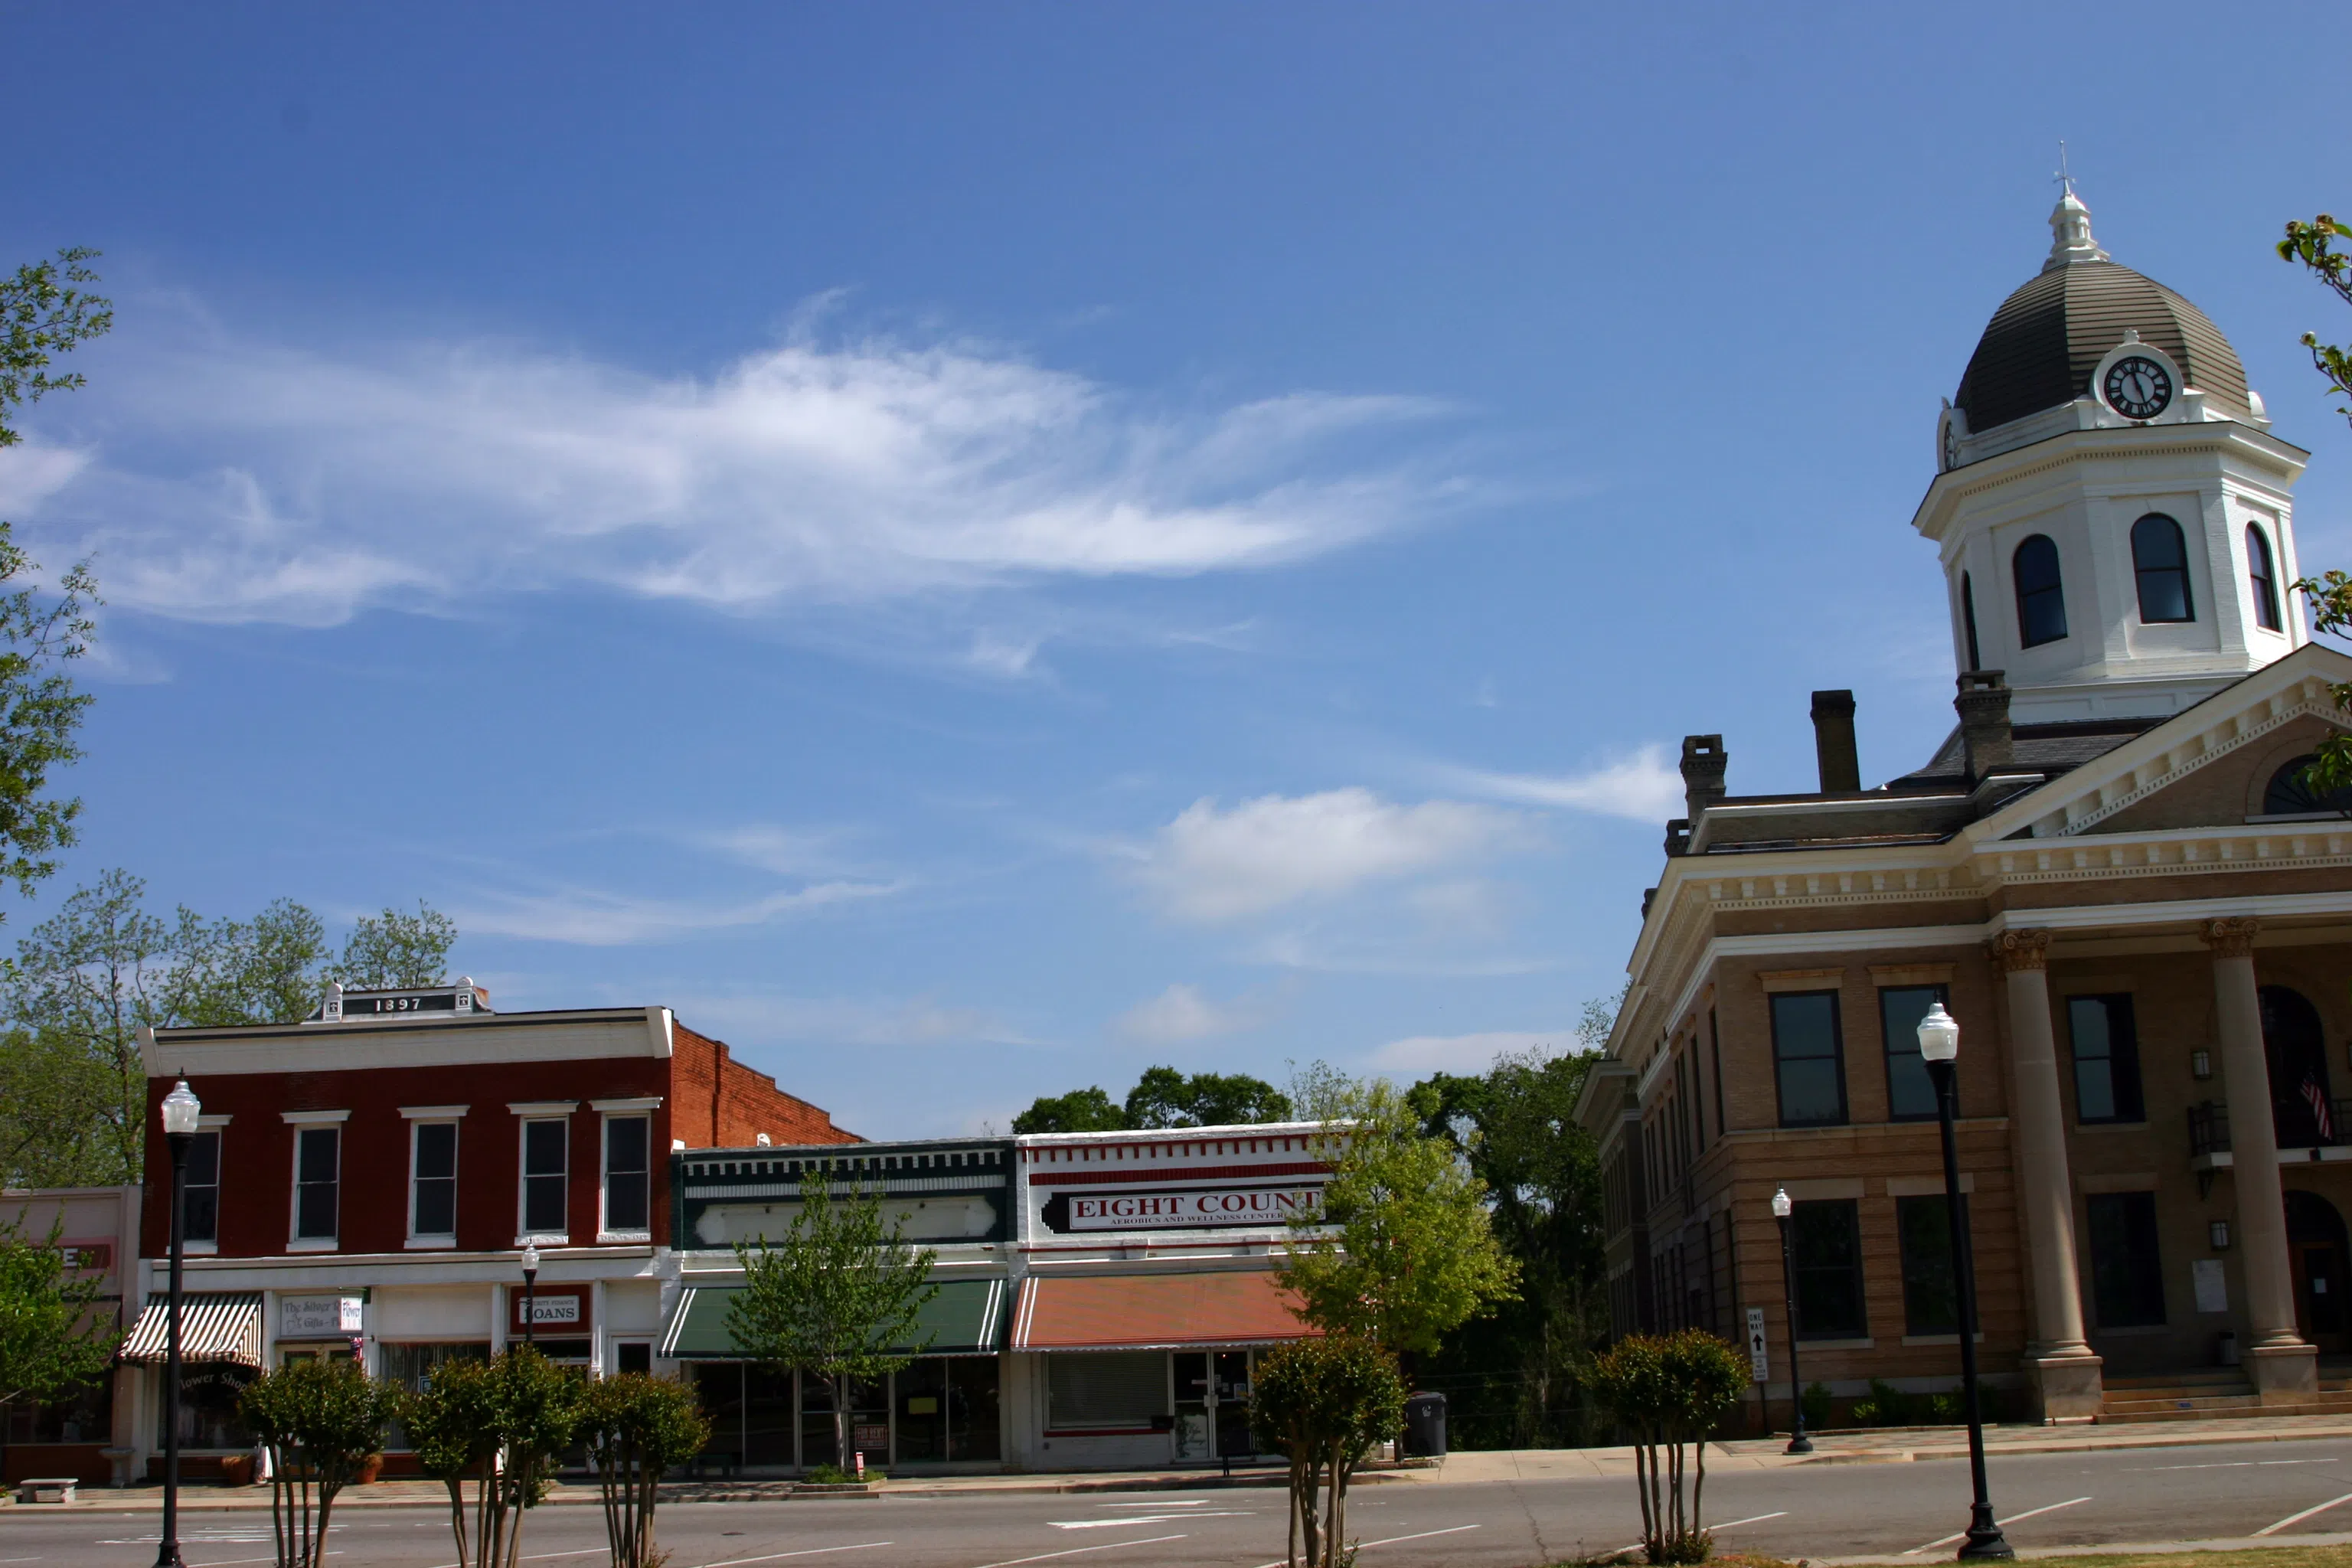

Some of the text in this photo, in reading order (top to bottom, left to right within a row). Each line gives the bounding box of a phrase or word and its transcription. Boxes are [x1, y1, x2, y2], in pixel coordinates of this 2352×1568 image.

[376, 998, 420, 1011] 1897
[1076, 1192, 1321, 1217] EIGHT COUNT
[1187, 1214, 1242, 1222] WELLNESS
[1749, 1313, 1762, 1321] ONE
[179, 1374, 215, 1390] lower
